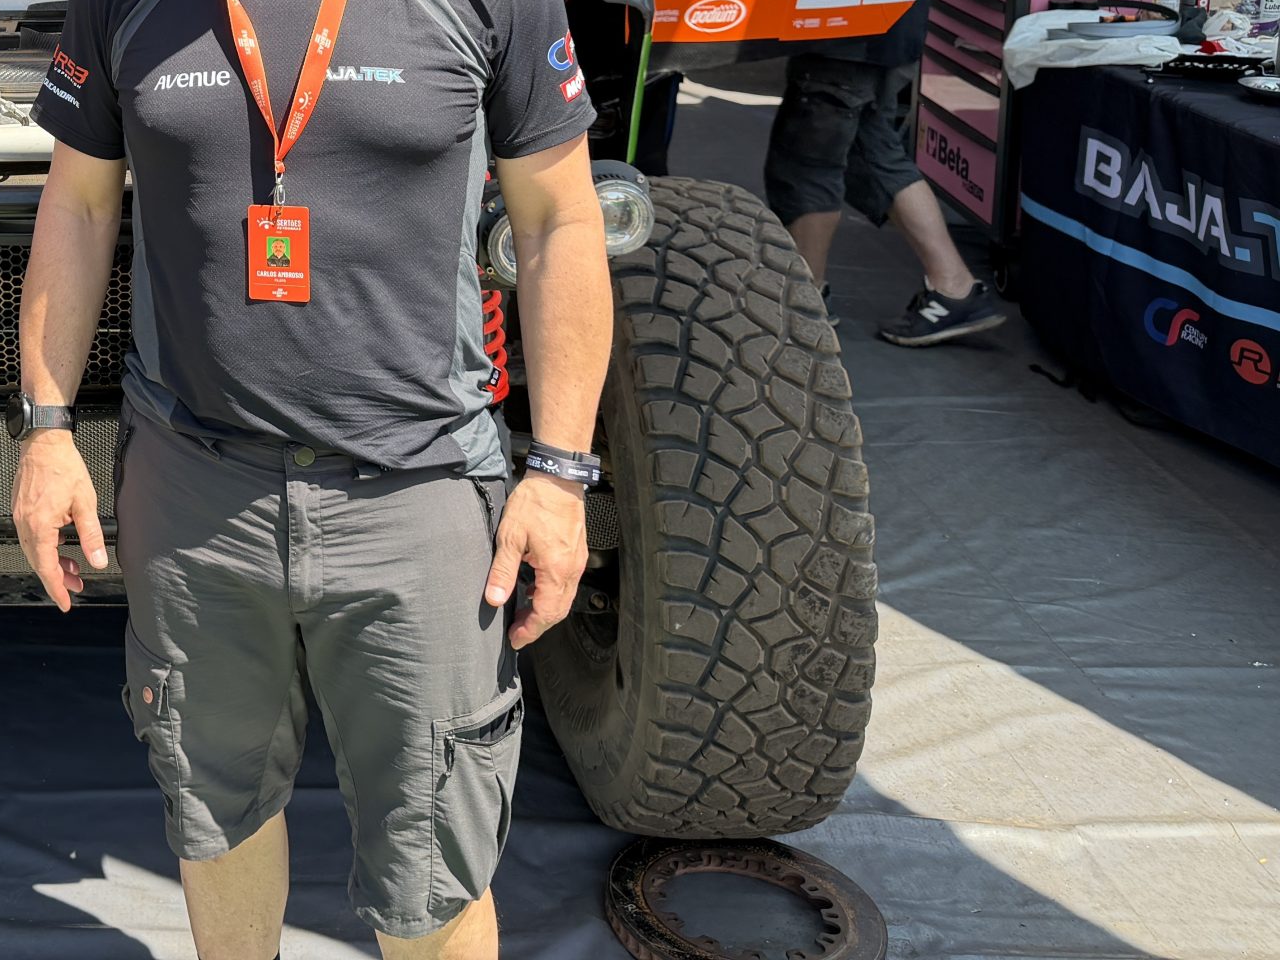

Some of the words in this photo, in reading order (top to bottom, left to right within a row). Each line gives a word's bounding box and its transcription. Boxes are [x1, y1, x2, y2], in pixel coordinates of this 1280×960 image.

[55, 51, 89, 85] R53
[325, 66, 406, 84] AJA.TEK
[938, 134, 969, 182] Beta
[1180, 330, 1204, 350] RACING
[1183, 323, 1208, 344] CENTURY
